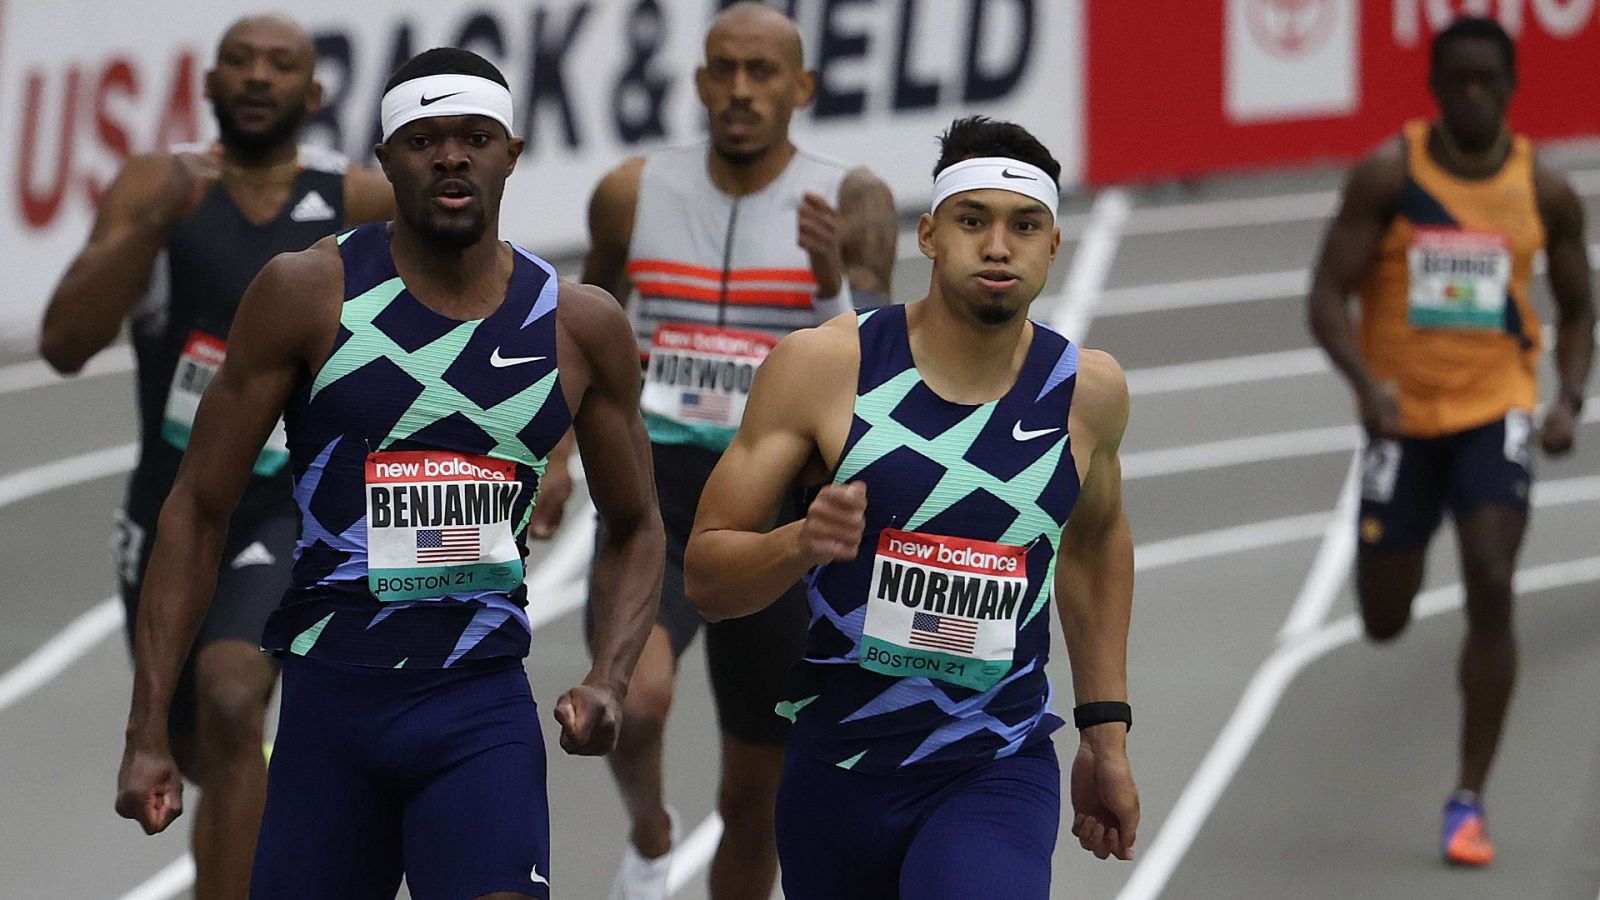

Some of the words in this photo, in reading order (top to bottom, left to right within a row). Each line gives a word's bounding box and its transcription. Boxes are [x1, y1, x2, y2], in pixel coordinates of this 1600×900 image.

[18, 50, 202, 230] USA
[375, 462, 420, 478] new
[423, 457, 506, 481] balance
[371, 483, 519, 528] BENJAMIN
[888, 538, 935, 560] new
[937, 543, 1018, 572] balance
[377, 573, 450, 593] BOSTON
[455, 571, 474, 585] 21
[877, 560, 1022, 621] NORMAN
[866, 646, 940, 672] BOSTON
[944, 660, 966, 677] 21
